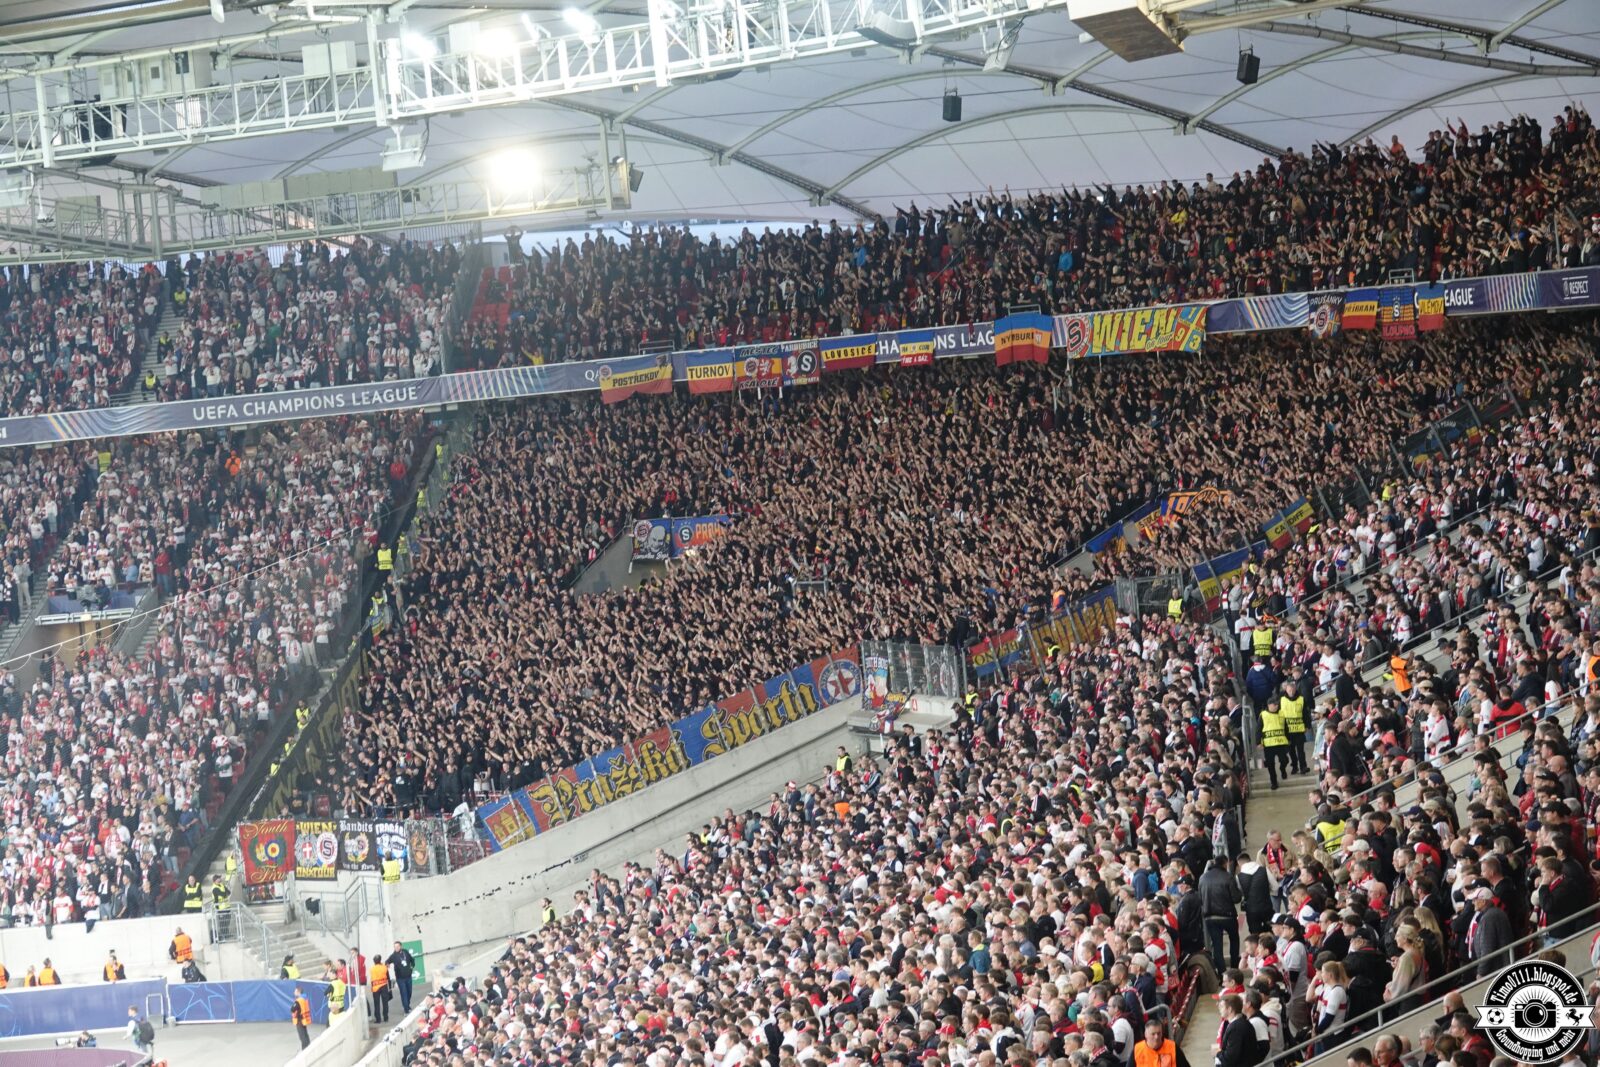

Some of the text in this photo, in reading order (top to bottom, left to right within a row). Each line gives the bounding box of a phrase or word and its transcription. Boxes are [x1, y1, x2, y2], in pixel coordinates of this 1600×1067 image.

[1569, 280, 1588, 294] RESPECT
[1444, 287, 1474, 306] EAGUE
[1092, 307, 1177, 353] WIEN
[824, 345, 872, 359] LOVOSICE
[688, 364, 730, 379] TURNOV
[192, 386, 418, 421] UEFA CHAMPIONS LEAGUE
[701, 679, 820, 761] Sparta
[243, 820, 289, 839] Youth
[300, 821, 333, 834] WIEN
[340, 820, 373, 833] Bandits
